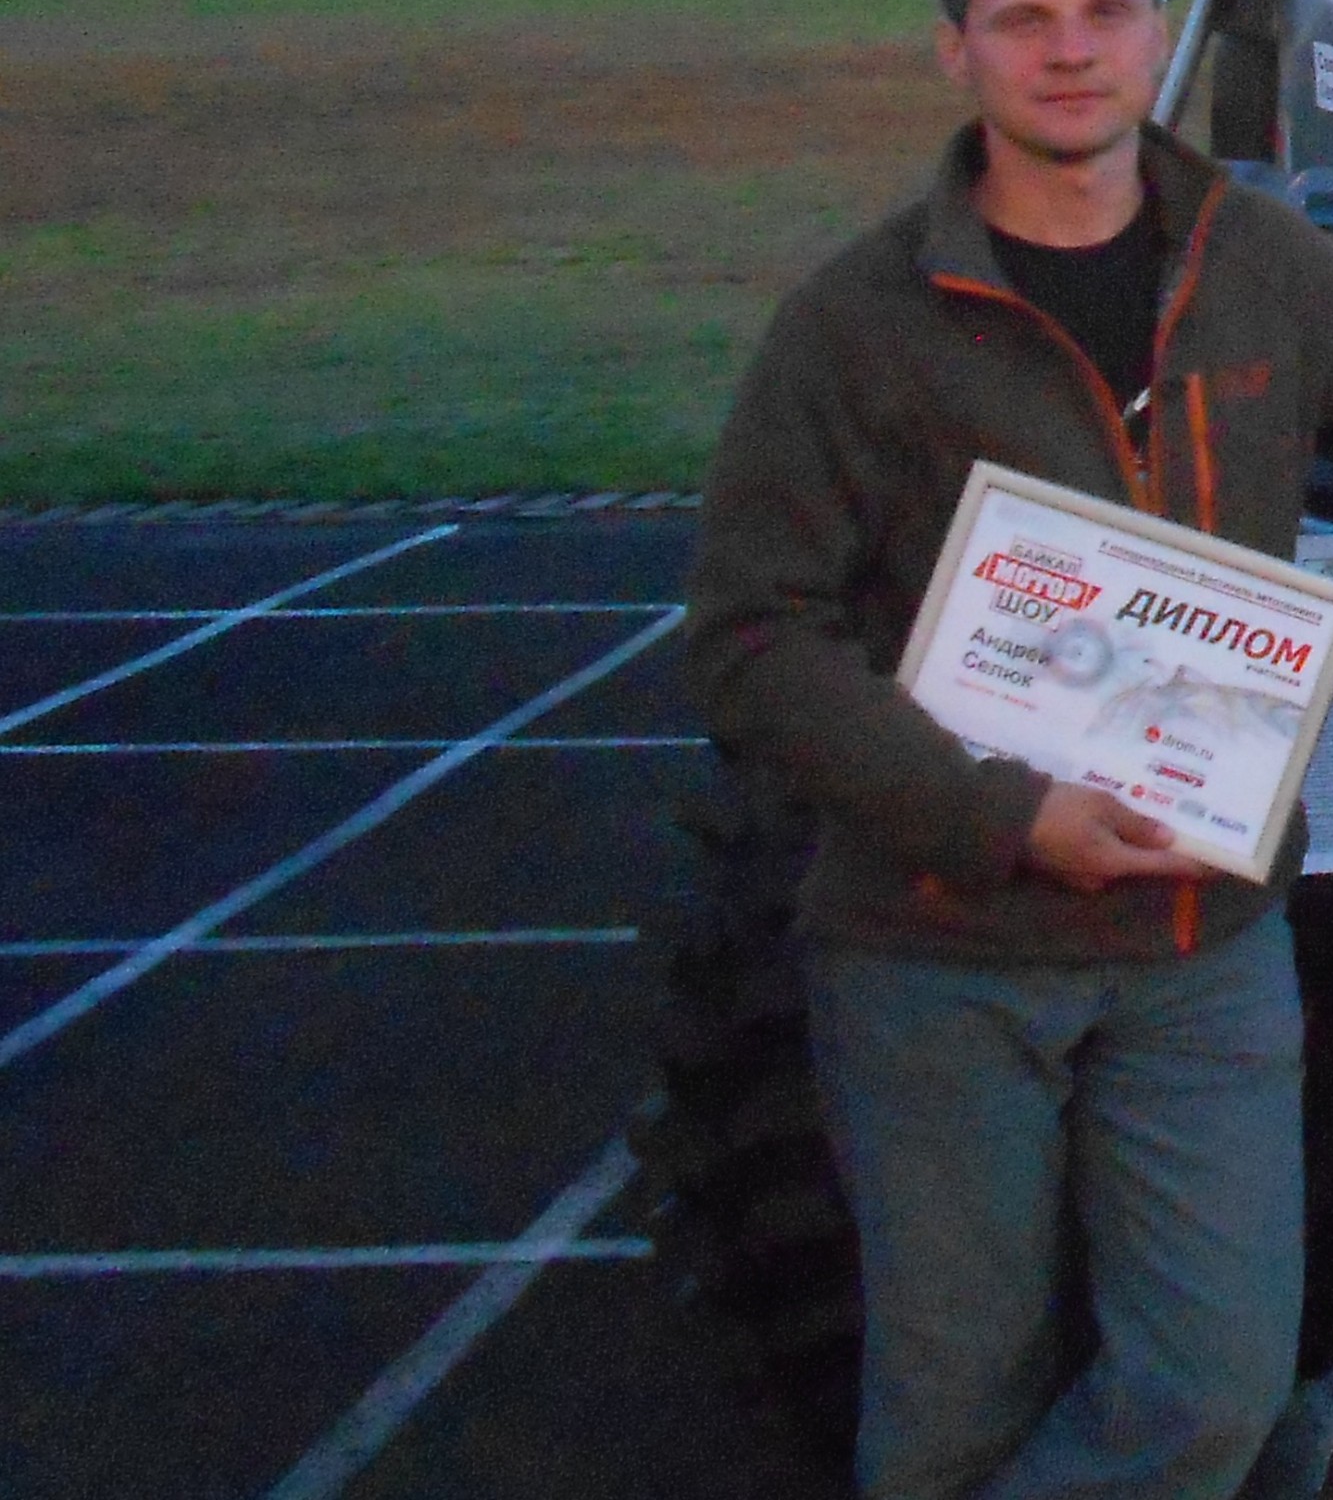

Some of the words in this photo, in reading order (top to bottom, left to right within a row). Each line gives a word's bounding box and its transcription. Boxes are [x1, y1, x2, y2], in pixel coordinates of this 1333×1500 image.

[1012, 544, 1082, 575] БАЙКАЛ
[991, 556, 1086, 605] МОТОР
[994, 589, 1060, 625] ШОУ
[970, 626, 1052, 668] Андрей
[1115, 587, 1313, 674] ДИПЛОМ
[962, 650, 1034, 688] Селюк
[1161, 733, 1214, 761] drom.ru
